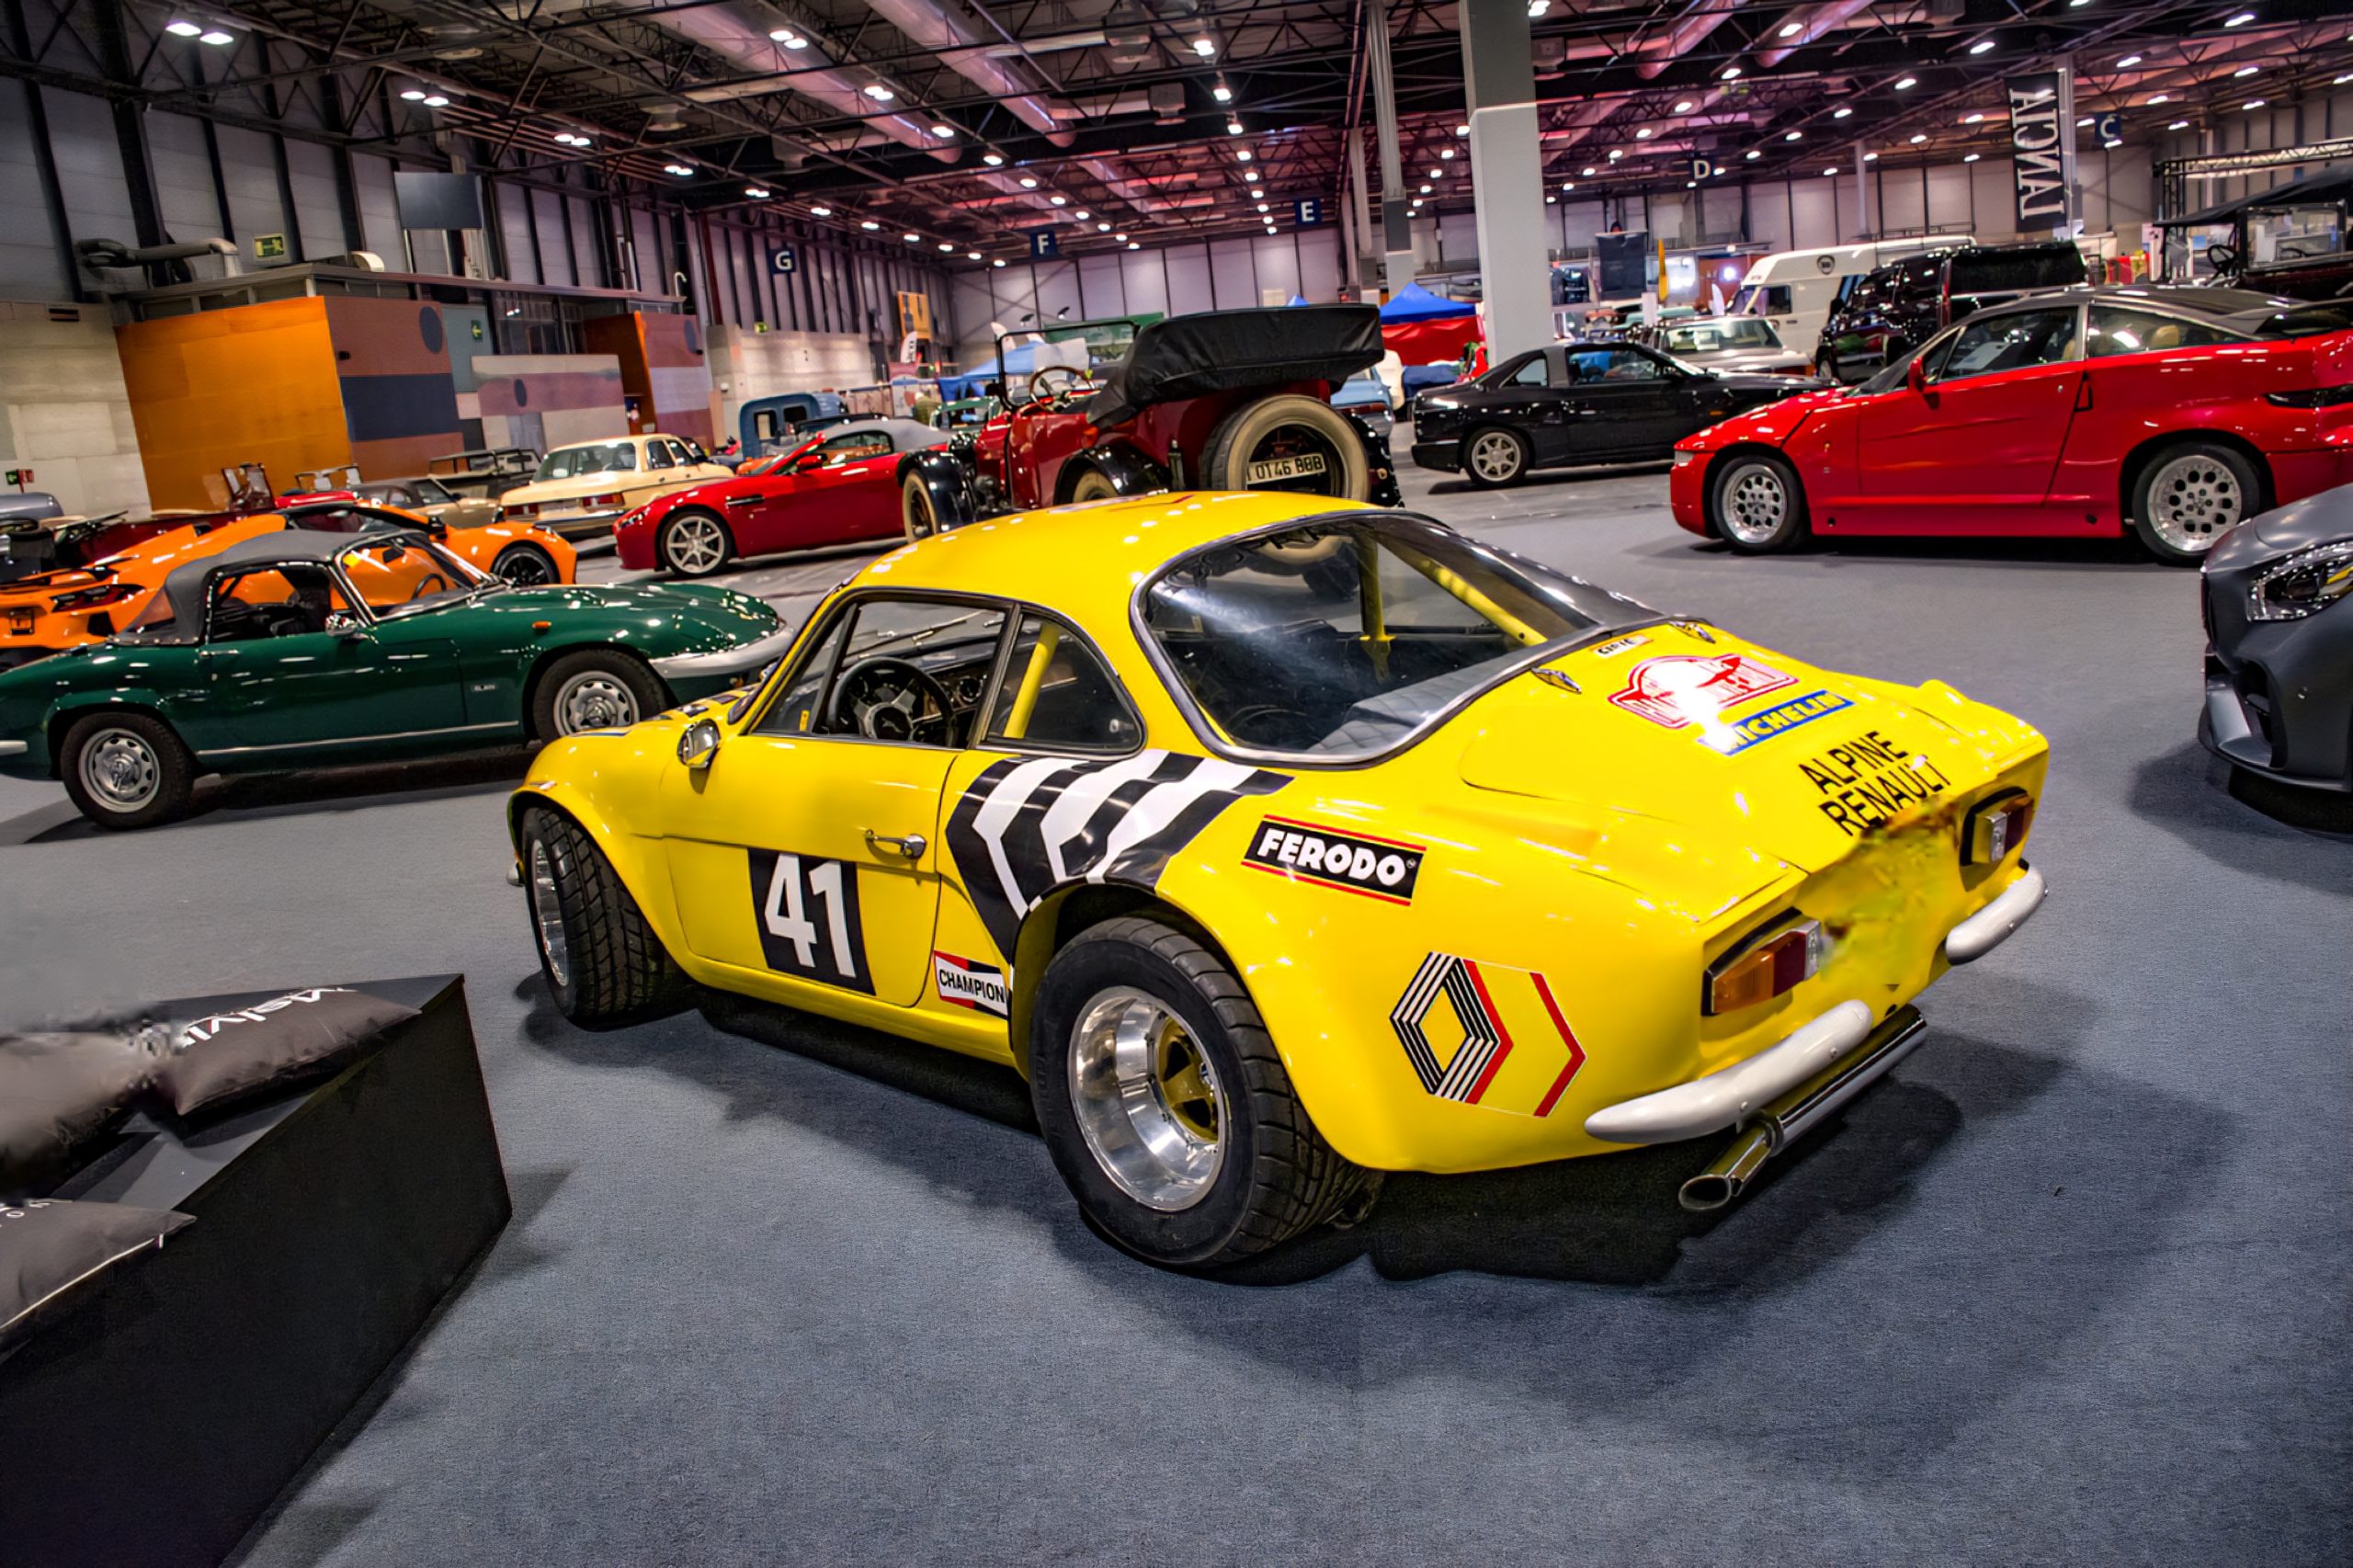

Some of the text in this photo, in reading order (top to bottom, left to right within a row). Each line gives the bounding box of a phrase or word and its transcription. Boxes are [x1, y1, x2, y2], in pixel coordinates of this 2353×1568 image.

[2099, 118, 2117, 139] C
[1693, 160, 1711, 179] D
[1300, 201, 1315, 222] E
[775, 250, 793, 271] G
[1037, 233, 1050, 255] F
[1705, 693, 1847, 750] ICHELIN
[1799, 731, 1909, 795] ALPINE
[1819, 755, 1951, 836] RENAULT
[1256, 827, 1407, 887] FERODO
[765, 852, 858, 979] 41
[938, 969, 1006, 1004] CHAMPION
